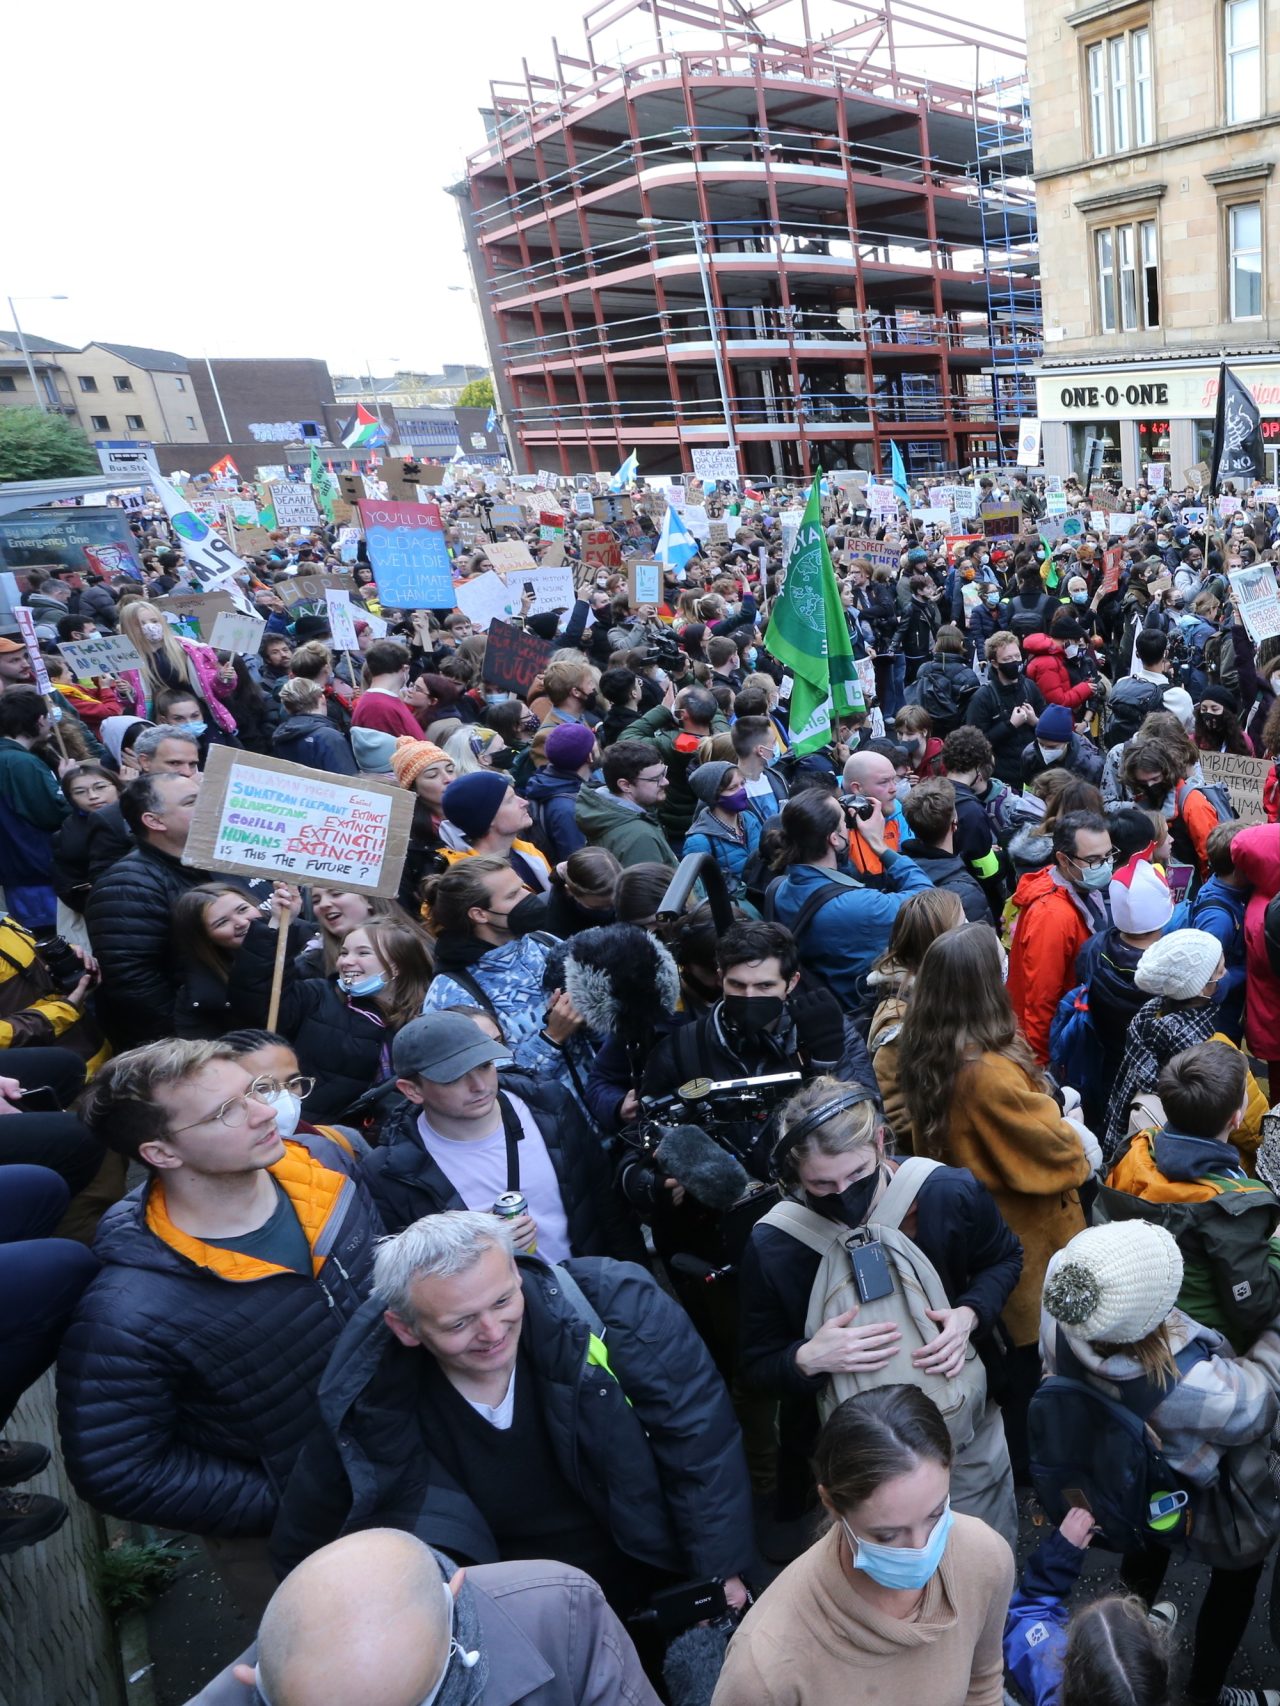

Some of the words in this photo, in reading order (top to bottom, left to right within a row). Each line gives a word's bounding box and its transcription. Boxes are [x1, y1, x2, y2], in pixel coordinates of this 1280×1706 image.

[276, 496, 312, 505] DEMAND
[278, 507, 316, 515] CLIMATE
[279, 516, 319, 525] JUSTICE
[366, 510, 415, 526] YOU'LL
[417, 514, 437, 527] DIE
[22, 525, 40, 535] the
[66, 525, 76, 534] of
[8, 536, 67, 549] Emergency
[69, 535, 90, 545] One
[369, 534, 407, 550] OLD
[407, 535, 442, 550] AGE
[847, 540, 884, 552] RESPECT
[374, 552, 417, 568] WE'LL
[417, 554, 445, 569] DIE
[396, 573, 450, 589] CLIMATE
[383, 588, 445, 602] CHANGE
[1248, 610, 1263, 620] FOR
[1263, 605, 1278, 615] OUR
[1254, 622, 1269, 631] FOR
[228, 813, 286, 834] GORILLA
[220, 826, 282, 849] HUMANS
[219, 846, 232, 855] IS
[243, 848, 267, 861] THIS
[273, 853, 295, 867] THE
[306, 859, 352, 875] FUTURE
[359, 868, 369, 879] ?
